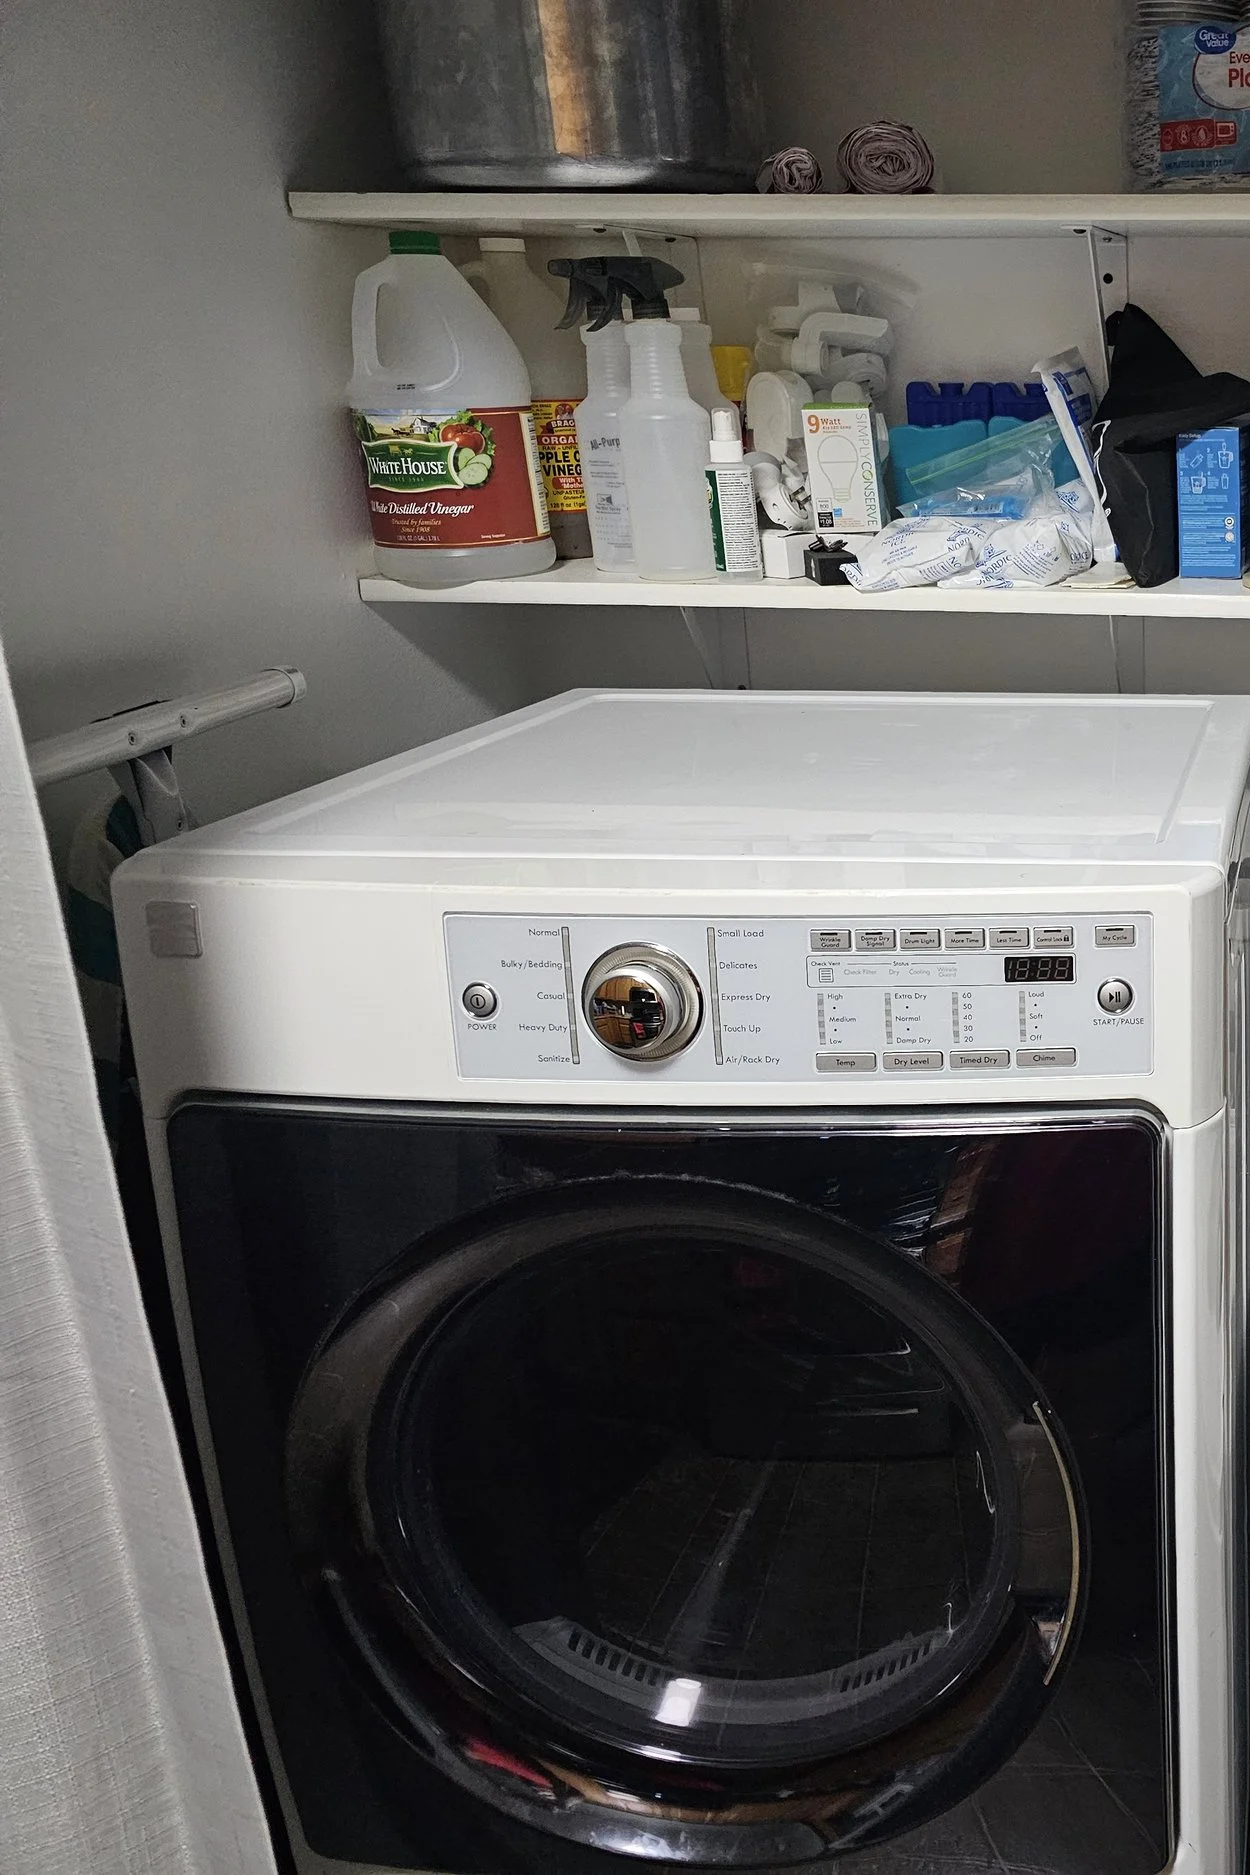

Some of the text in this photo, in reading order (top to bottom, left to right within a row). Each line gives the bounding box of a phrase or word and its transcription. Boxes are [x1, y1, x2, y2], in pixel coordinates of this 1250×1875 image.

[1199, 29, 1229, 40] Great
[807, 415, 820, 434] 9
[370, 500, 475, 518] White Distilled Vinegar
[410, 518, 418, 526] by
[417, 518, 442, 526] families
[528, 928, 560, 937] Normal
[717, 929, 765, 938] Small Load
[860, 935, 890, 943] Damp Dry
[501, 959, 563, 970] Bulky/Bedding
[719, 962, 758, 970] Delicates
[536, 992, 566, 1000] Casual
[721, 993, 771, 1002] Express Dry
[827, 993, 843, 1001] High
[914, 993, 928, 1001] Dry
[1093, 1018, 1145, 1027] START/PAUSE
[519, 1024, 568, 1033] Heavy Duty
[723, 1024, 762, 1034] Touch Up
[896, 1037, 932, 1045] Damp Dry
[1029, 1034, 1043, 1042] Off
[537, 1055, 571, 1063] Sanitize
[725, 1055, 780, 1065] Air/Rack Dry
[835, 1059, 856, 1067] Temp
[894, 1058, 908, 1066] Dry
[960, 1056, 998, 1065] Timed Dry
